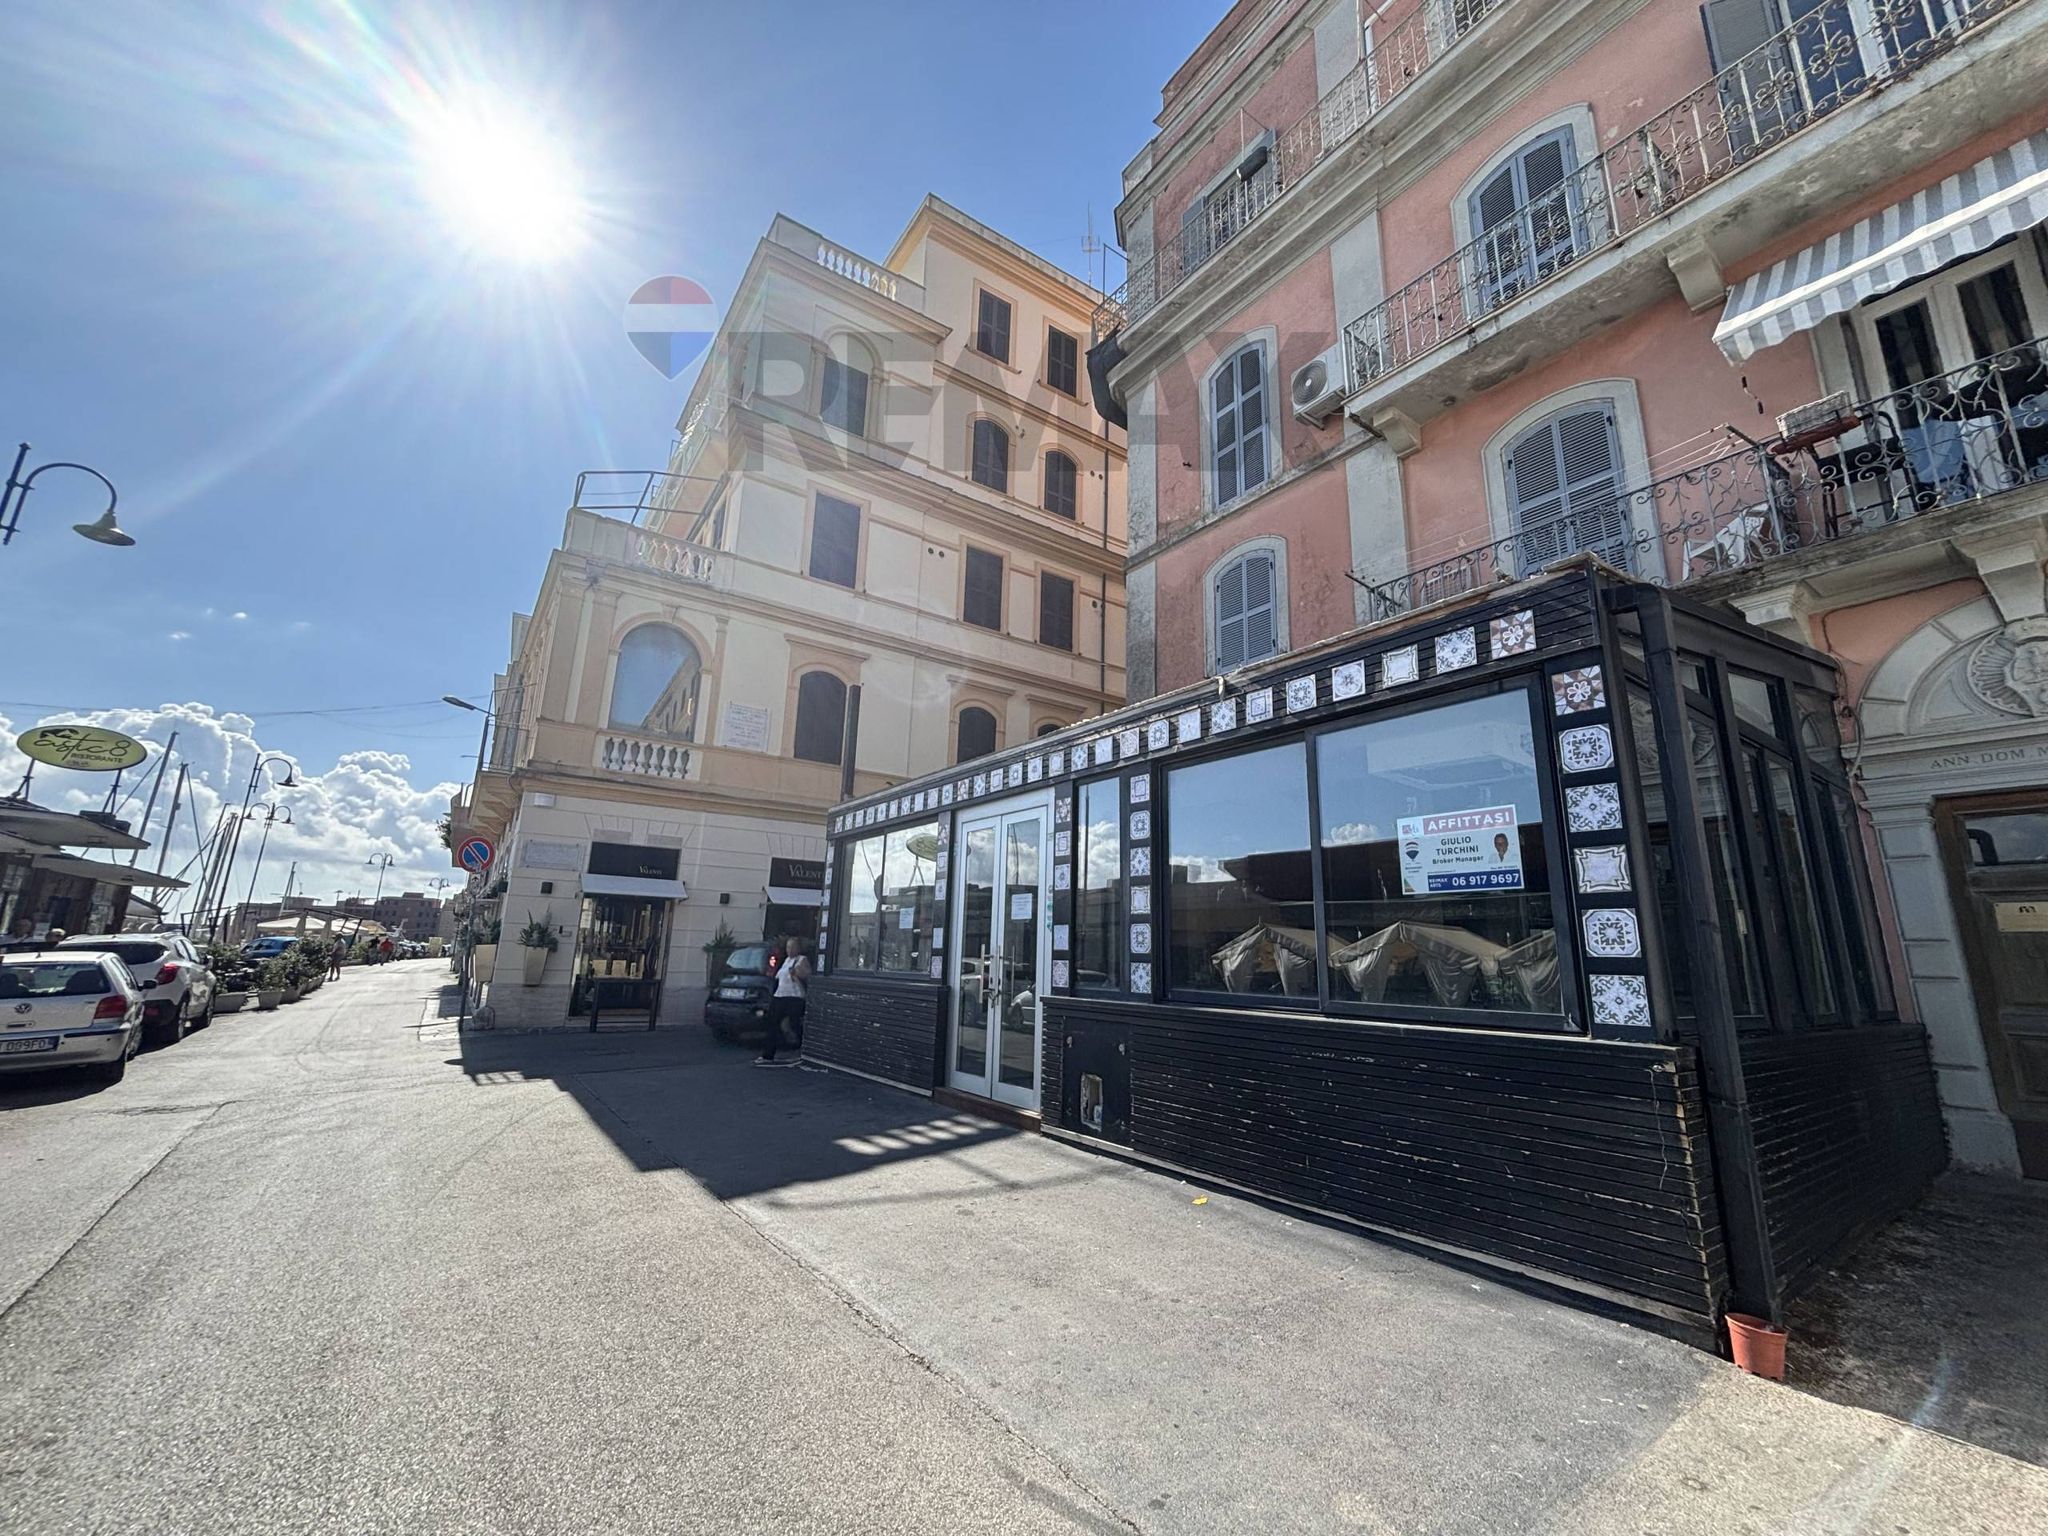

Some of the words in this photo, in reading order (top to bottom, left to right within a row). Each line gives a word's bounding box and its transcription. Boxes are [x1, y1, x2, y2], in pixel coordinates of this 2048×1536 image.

[1428, 811, 1510, 832] AFFITTASI
[1441, 836, 1472, 846] GIULIO
[1436, 845, 1479, 856] TURCHINI
[1455, 855, 1484, 864] Manager
[1452, 876, 1467, 886] 06
[1469, 875, 1487, 885] 917
[1490, 873, 1519, 884] 9697
